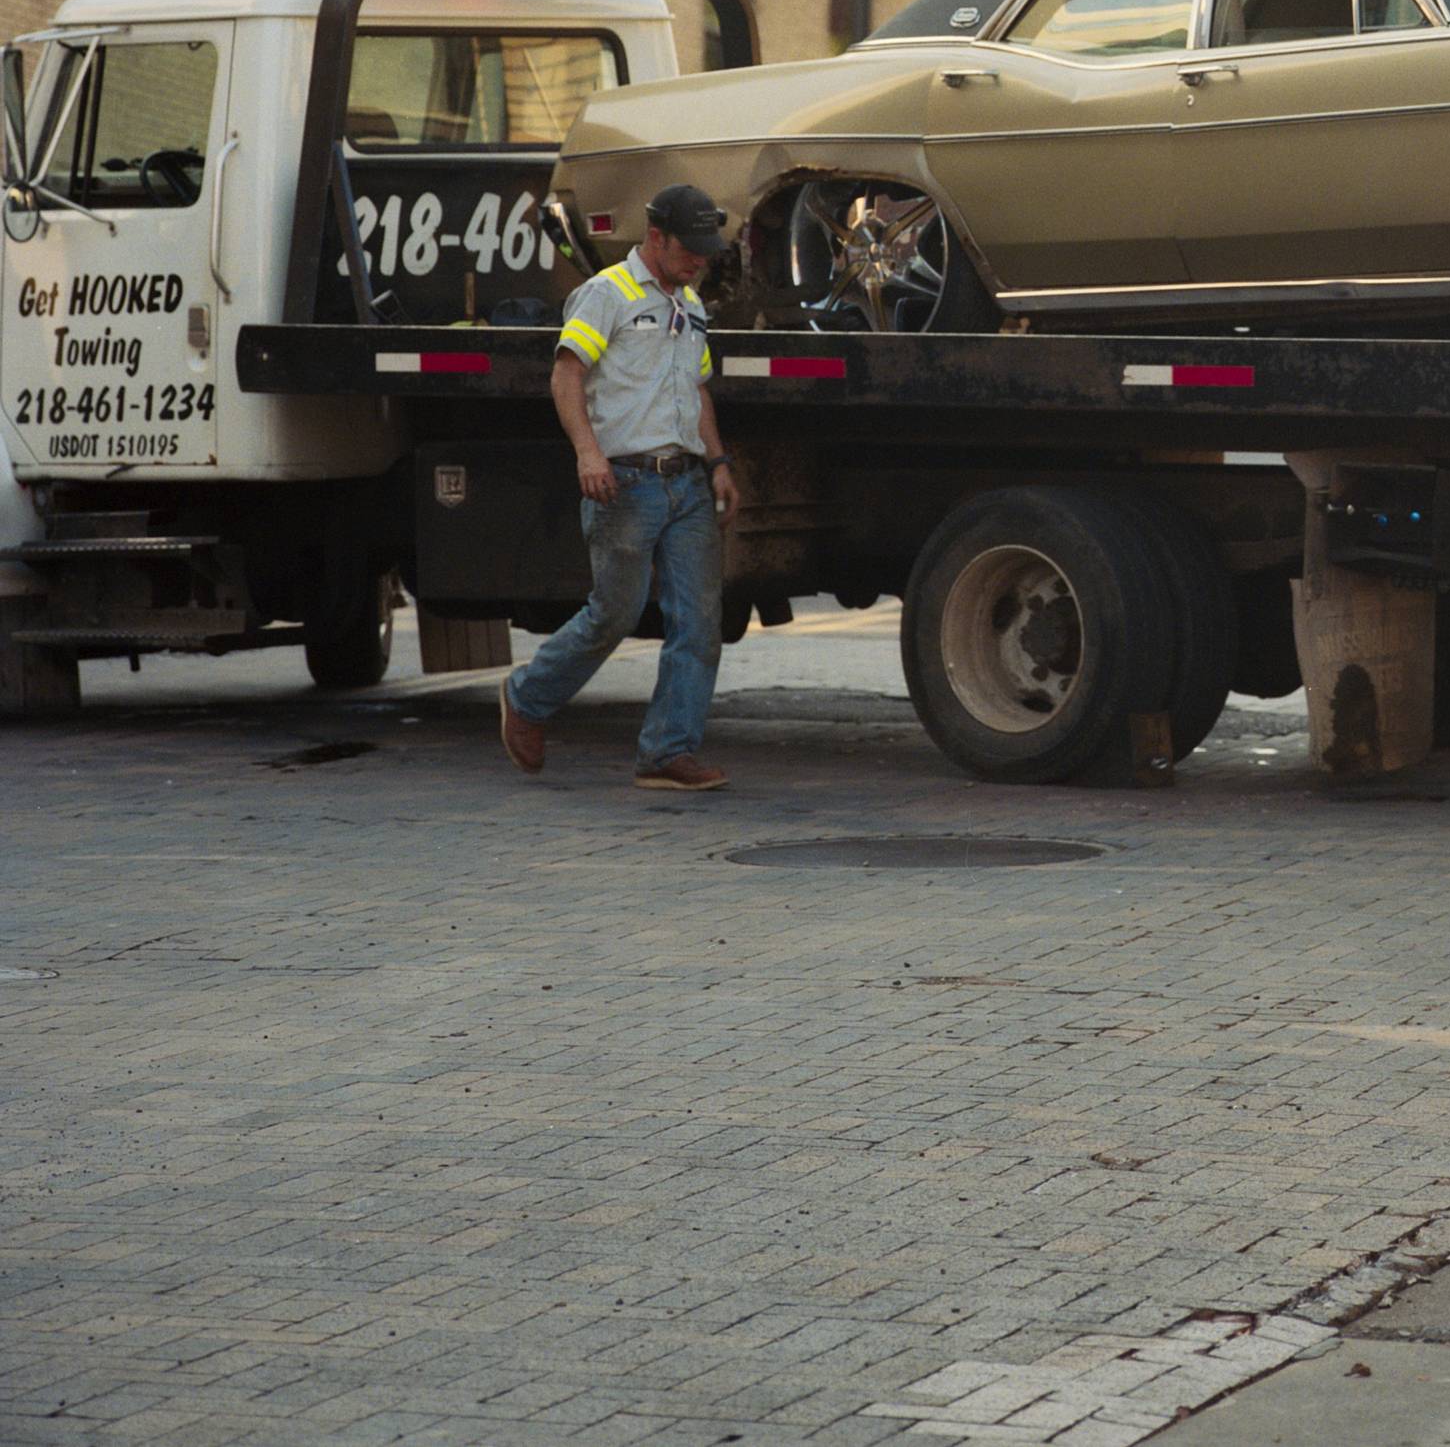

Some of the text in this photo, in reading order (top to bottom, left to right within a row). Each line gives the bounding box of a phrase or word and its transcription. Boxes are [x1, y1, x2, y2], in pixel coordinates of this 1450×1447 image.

[18, 273, 184, 318] Get HOOKED
[54, 326, 143, 378] Towing
[16, 382, 215, 425] 218-461-1234
[49, 433, 179, 458] USDOT 1510195
